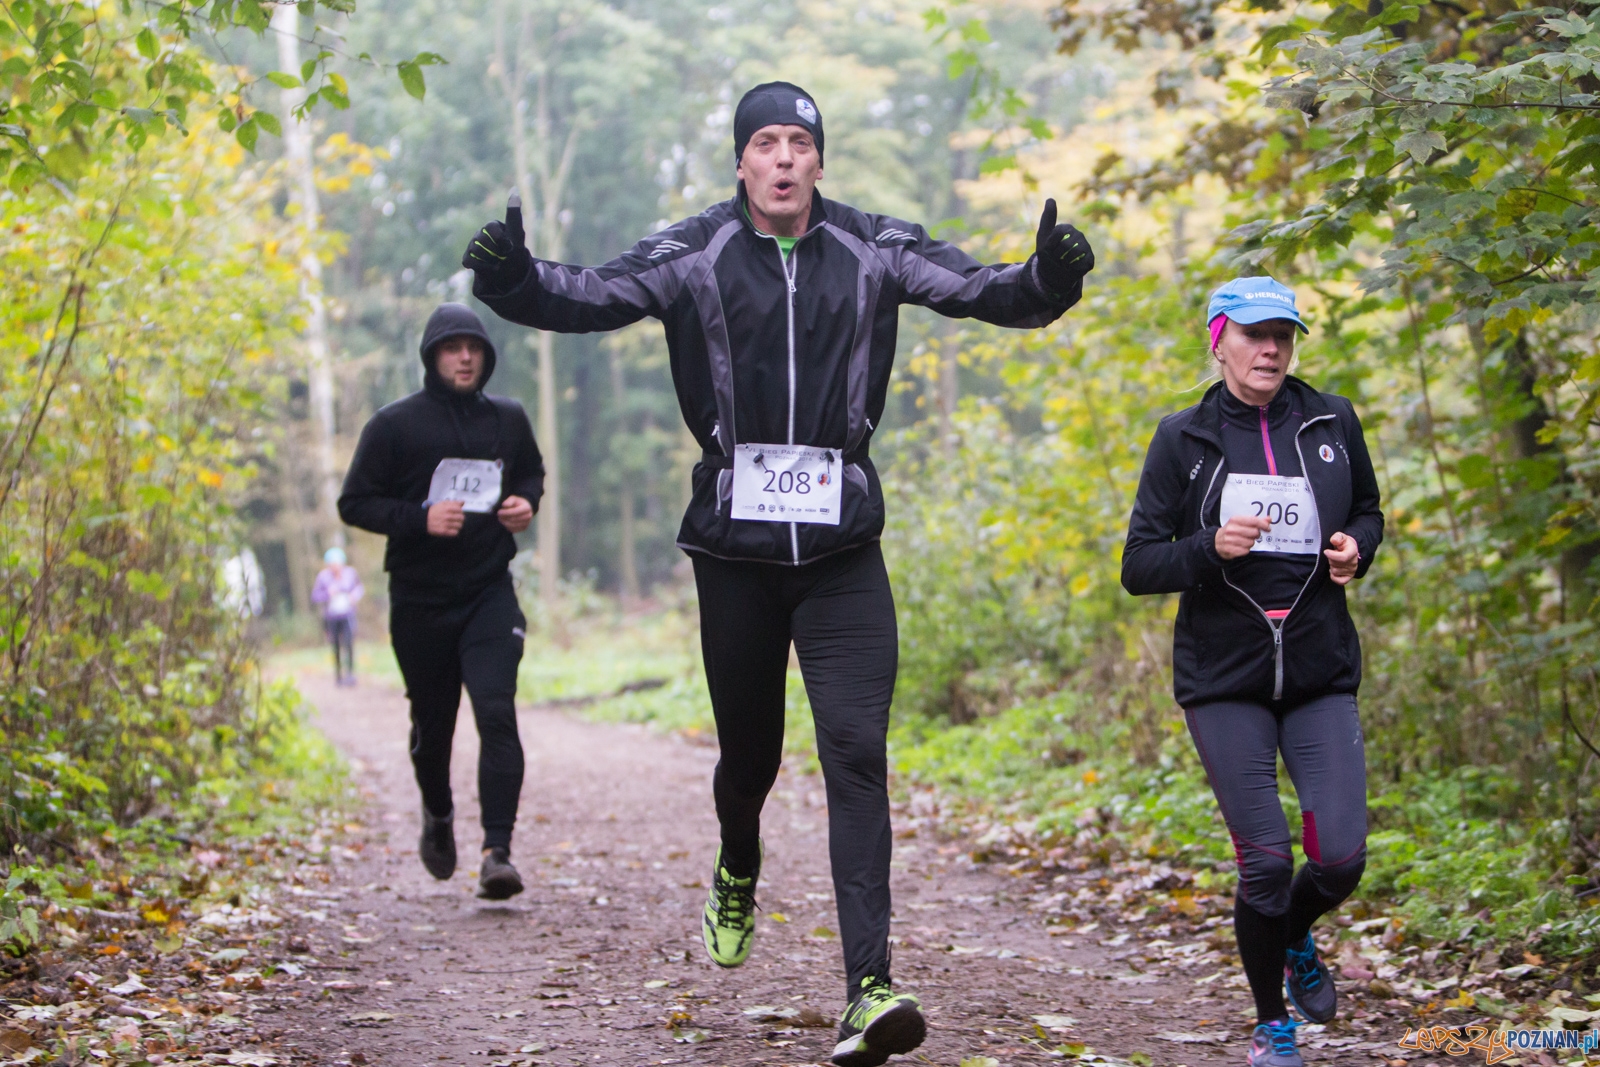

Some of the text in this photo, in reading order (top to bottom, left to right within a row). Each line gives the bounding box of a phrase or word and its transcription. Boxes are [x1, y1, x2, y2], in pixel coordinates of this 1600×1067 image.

[449, 475, 481, 493] 112
[762, 469, 811, 494] 208
[1251, 501, 1299, 526] 206
